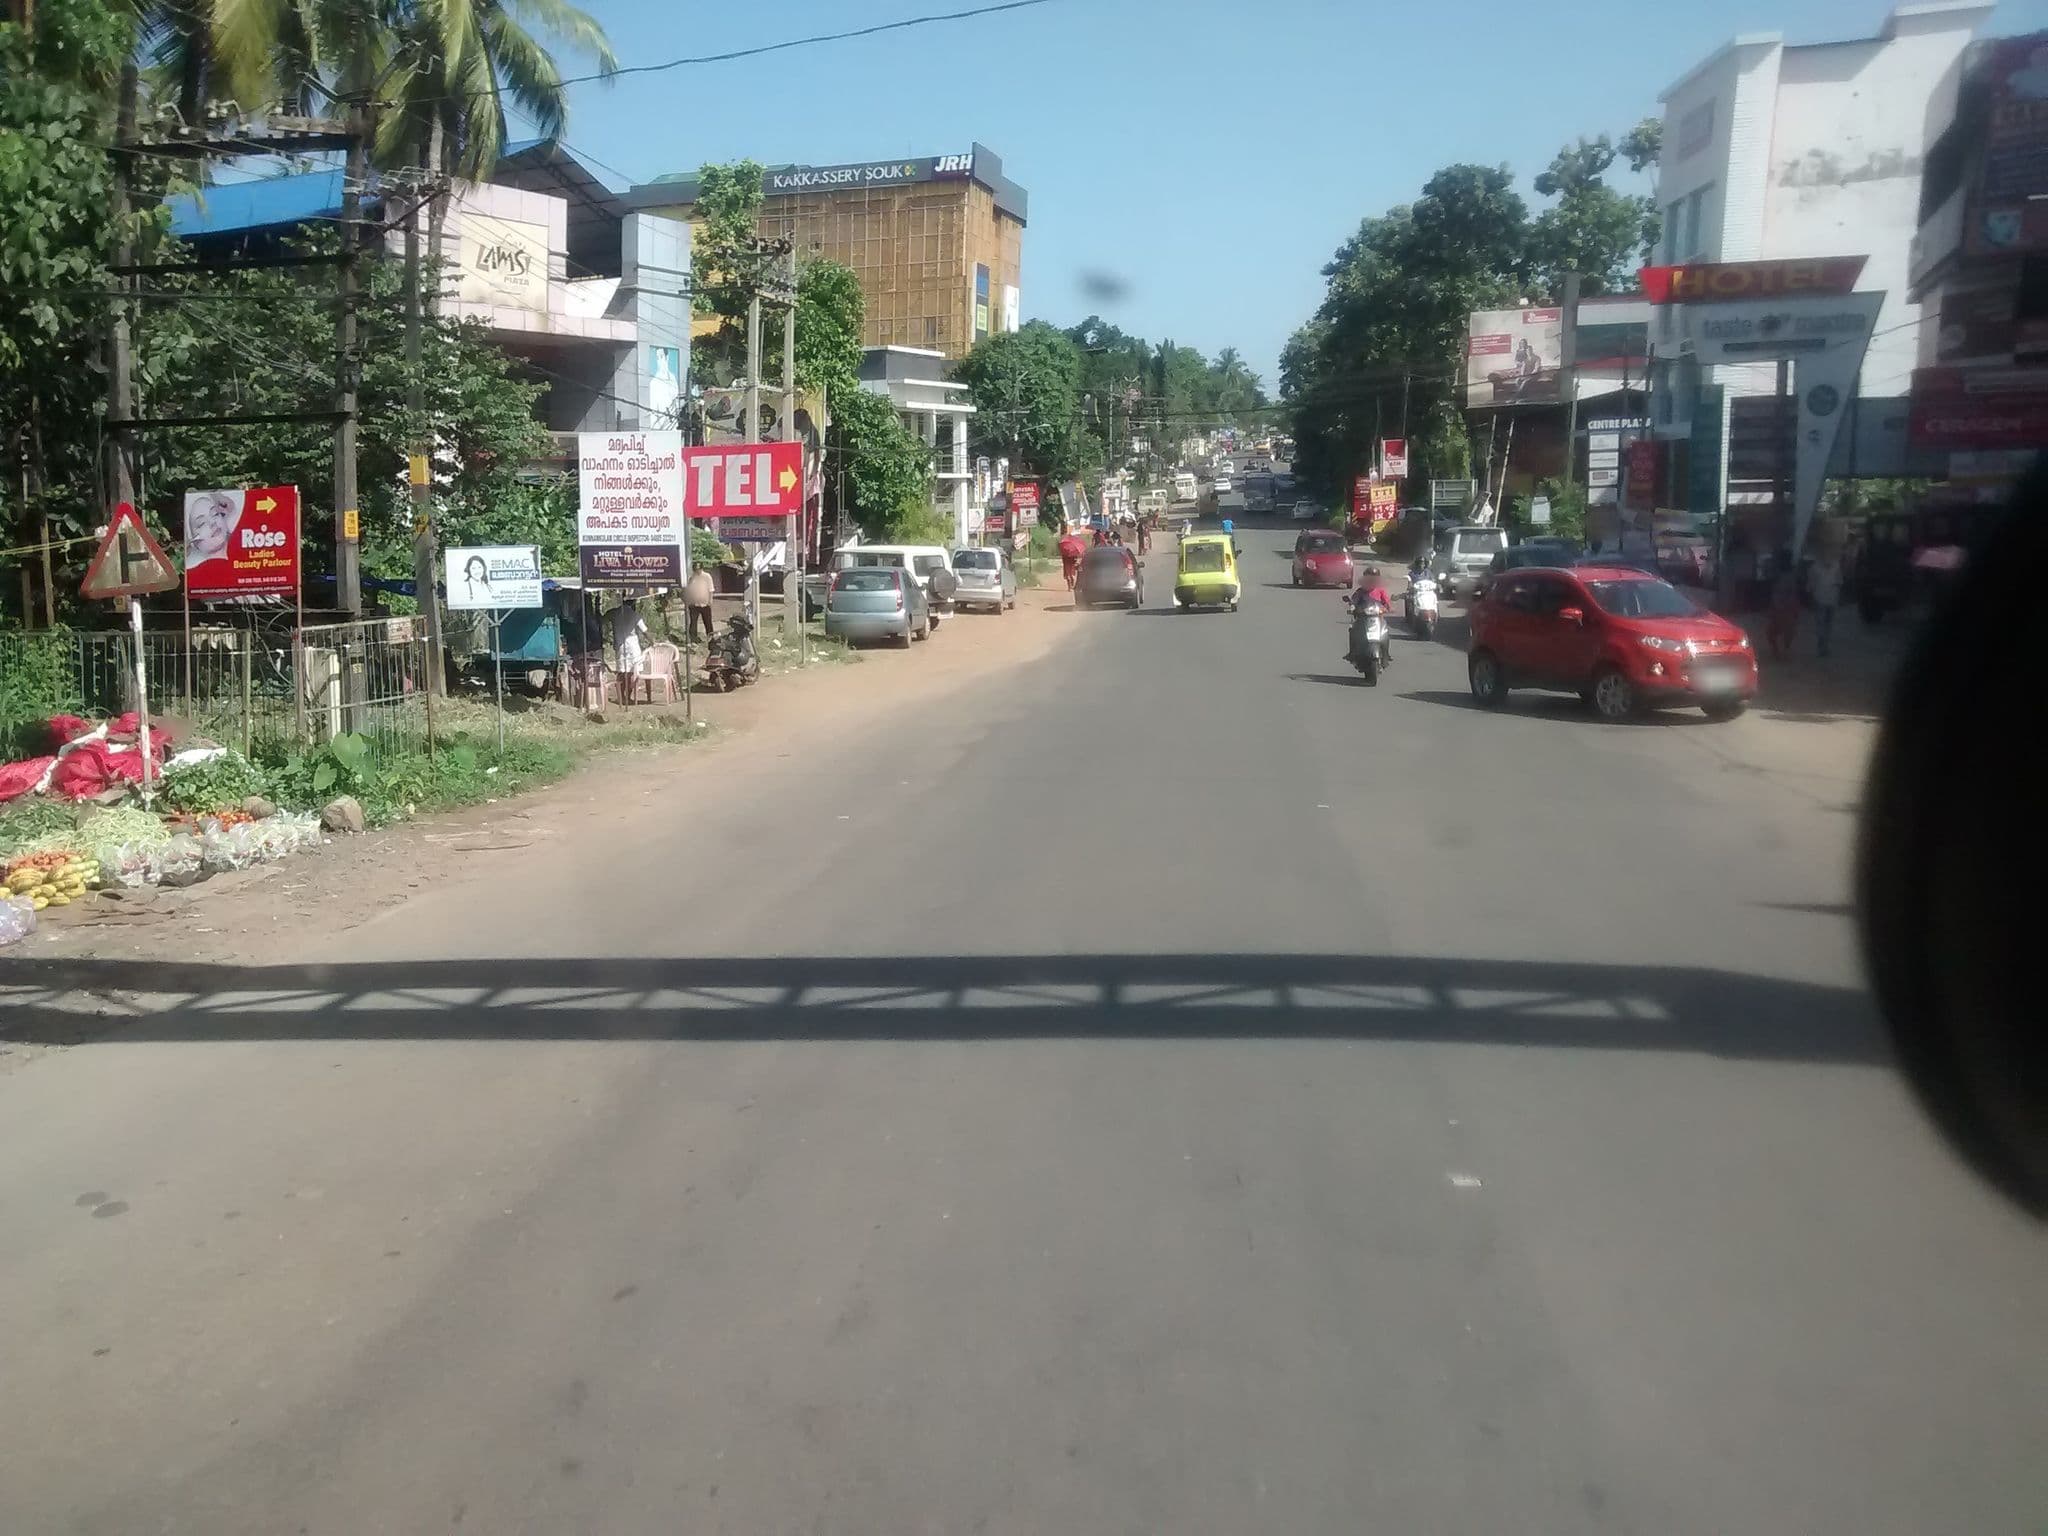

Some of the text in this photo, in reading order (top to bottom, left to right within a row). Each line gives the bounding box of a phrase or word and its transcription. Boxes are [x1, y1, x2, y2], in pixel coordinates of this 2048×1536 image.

[934, 154, 973, 172] JRH
[774, 165, 905, 188] KAKKASSERY SOUK
[1672, 262, 1836, 296] HOTEL
[1588, 418, 1620, 429] CENTRE
[582, 457, 624, 471] വാഹനം
[691, 453, 780, 507] TEL
[586, 515, 628, 529] അപകട
[241, 528, 286, 548] Rose
[249, 550, 275, 559] Ladies
[593, 554, 669, 568] LIWA TOWER
[233, 558, 292, 570] Beauty Parlour
